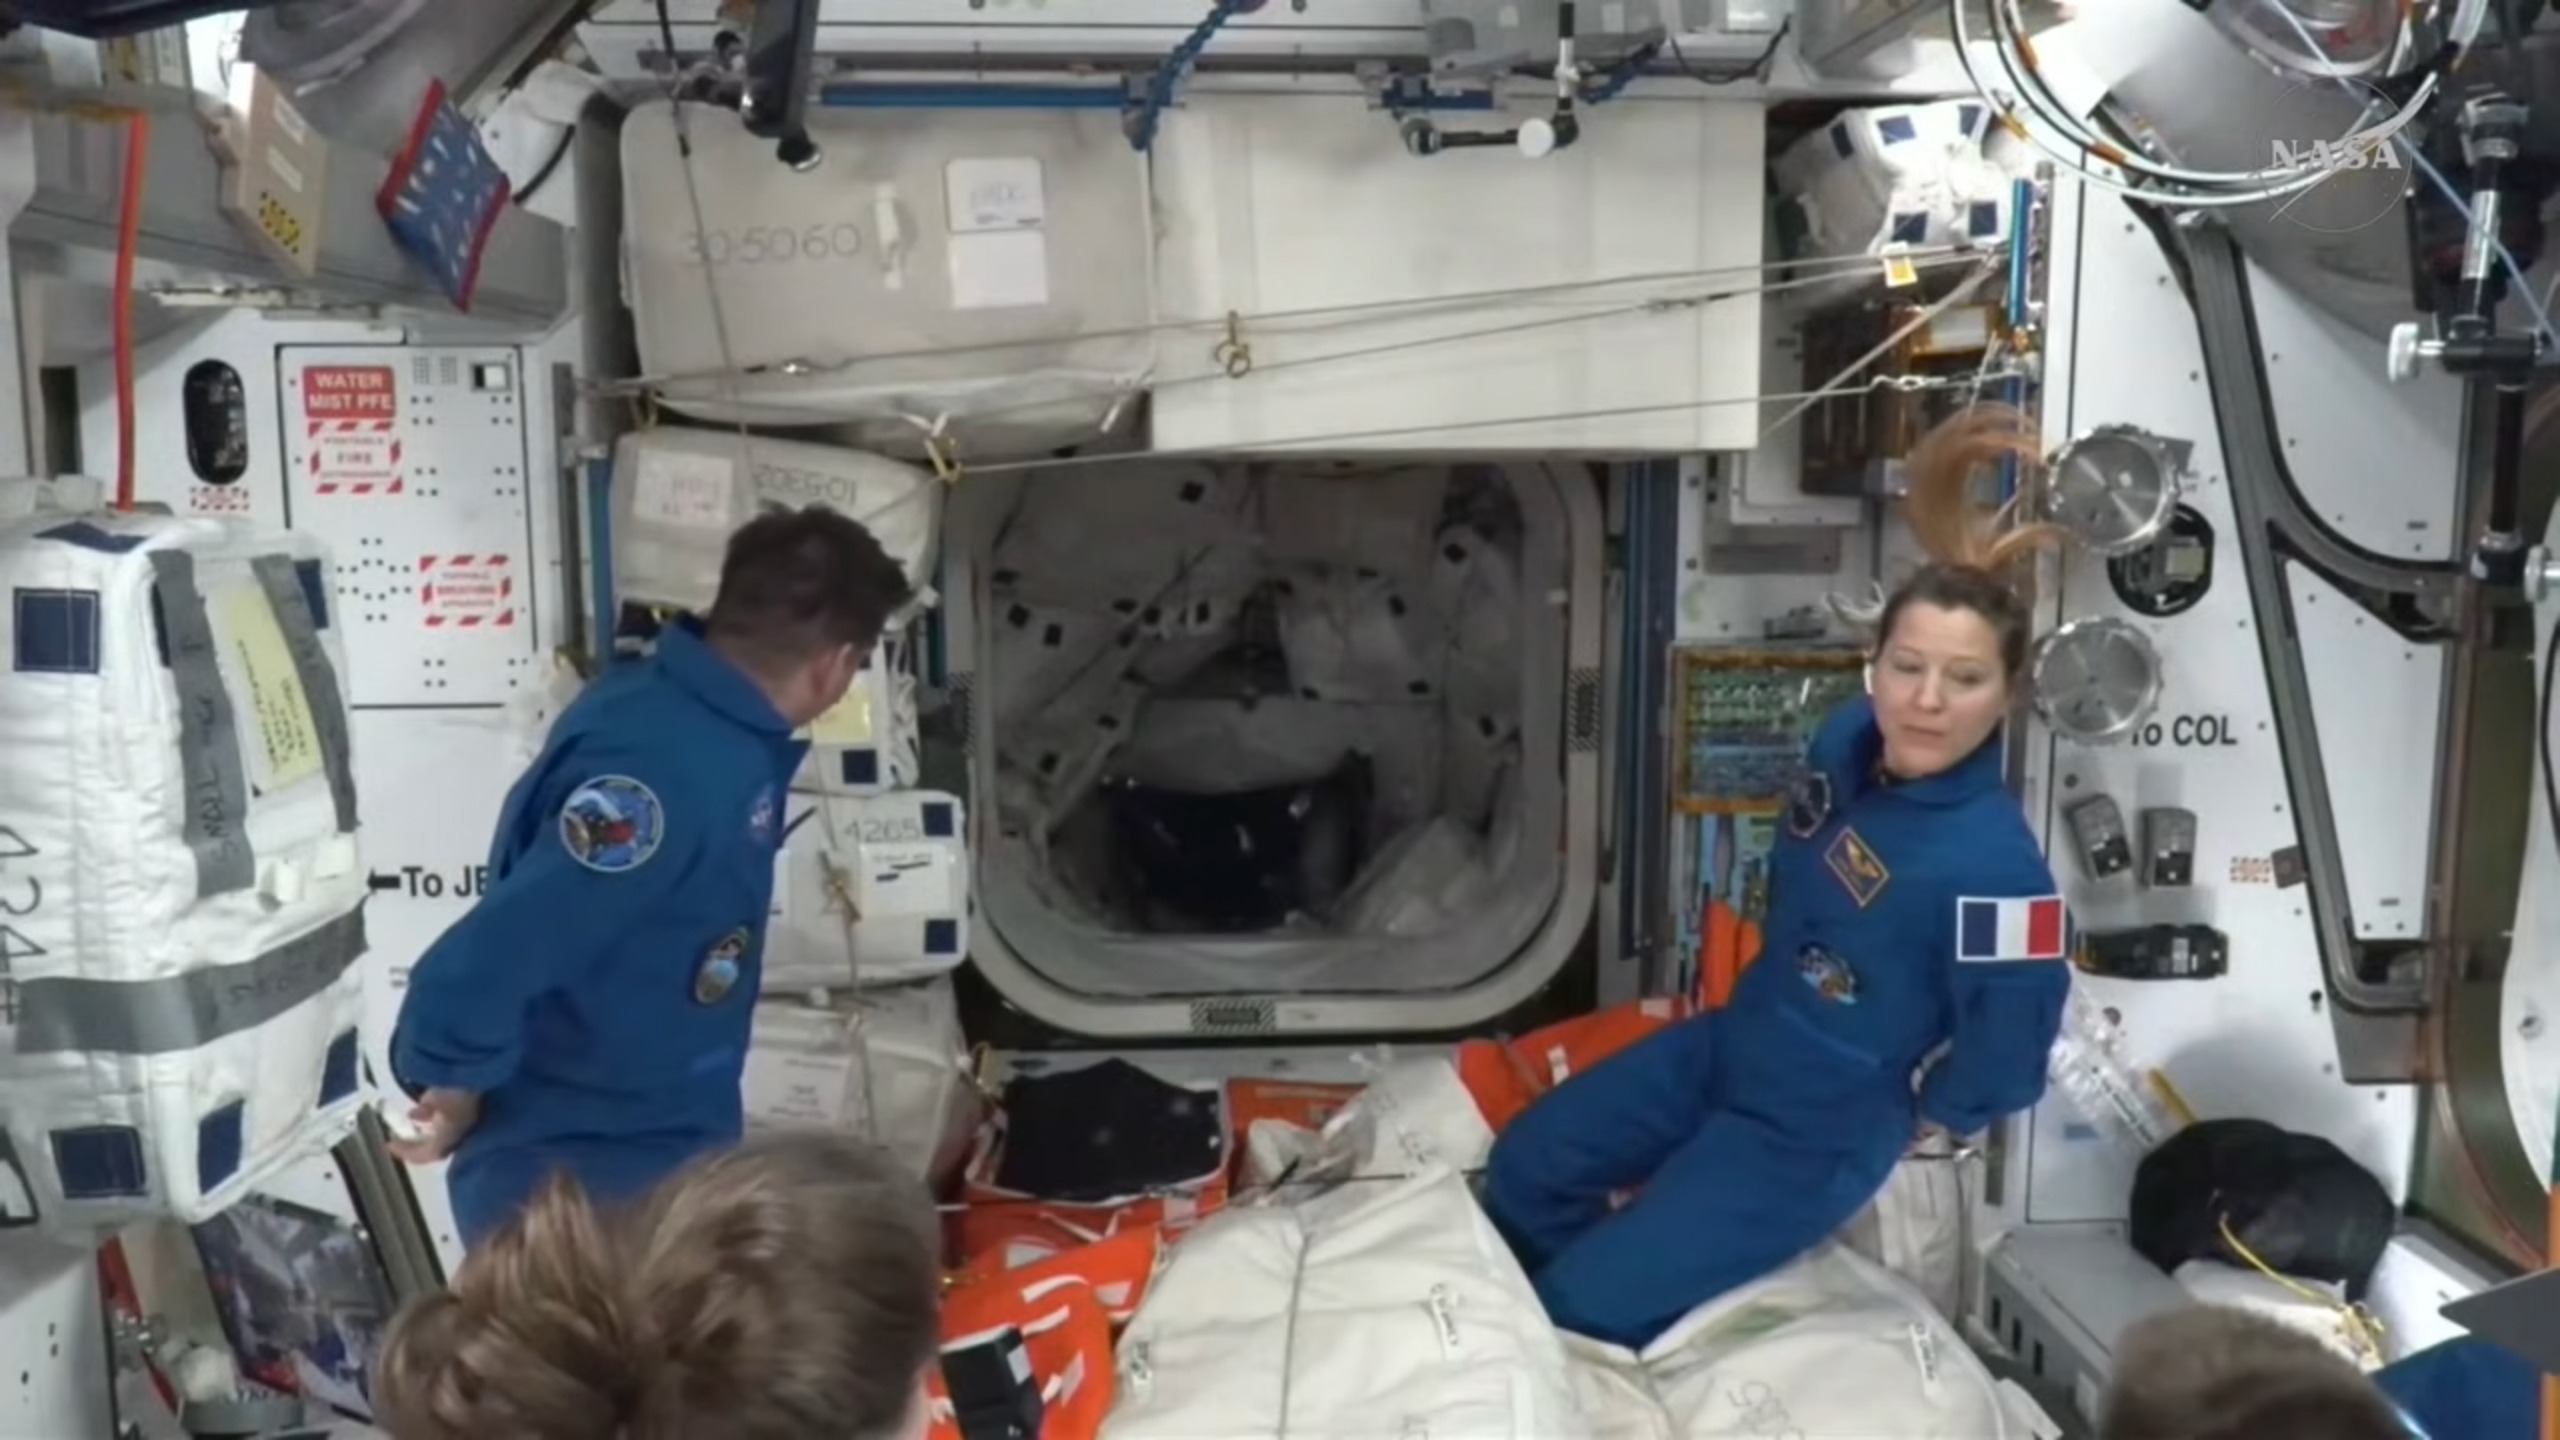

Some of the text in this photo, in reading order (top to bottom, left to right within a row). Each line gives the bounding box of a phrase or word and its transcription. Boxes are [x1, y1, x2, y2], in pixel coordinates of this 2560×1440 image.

[314, 372, 384, 390] WATER
[308, 393, 393, 410] MIST PFE
[336, 451, 372, 465] FIRE
[2172, 714, 2238, 747] COL
[401, 866, 443, 898] To
